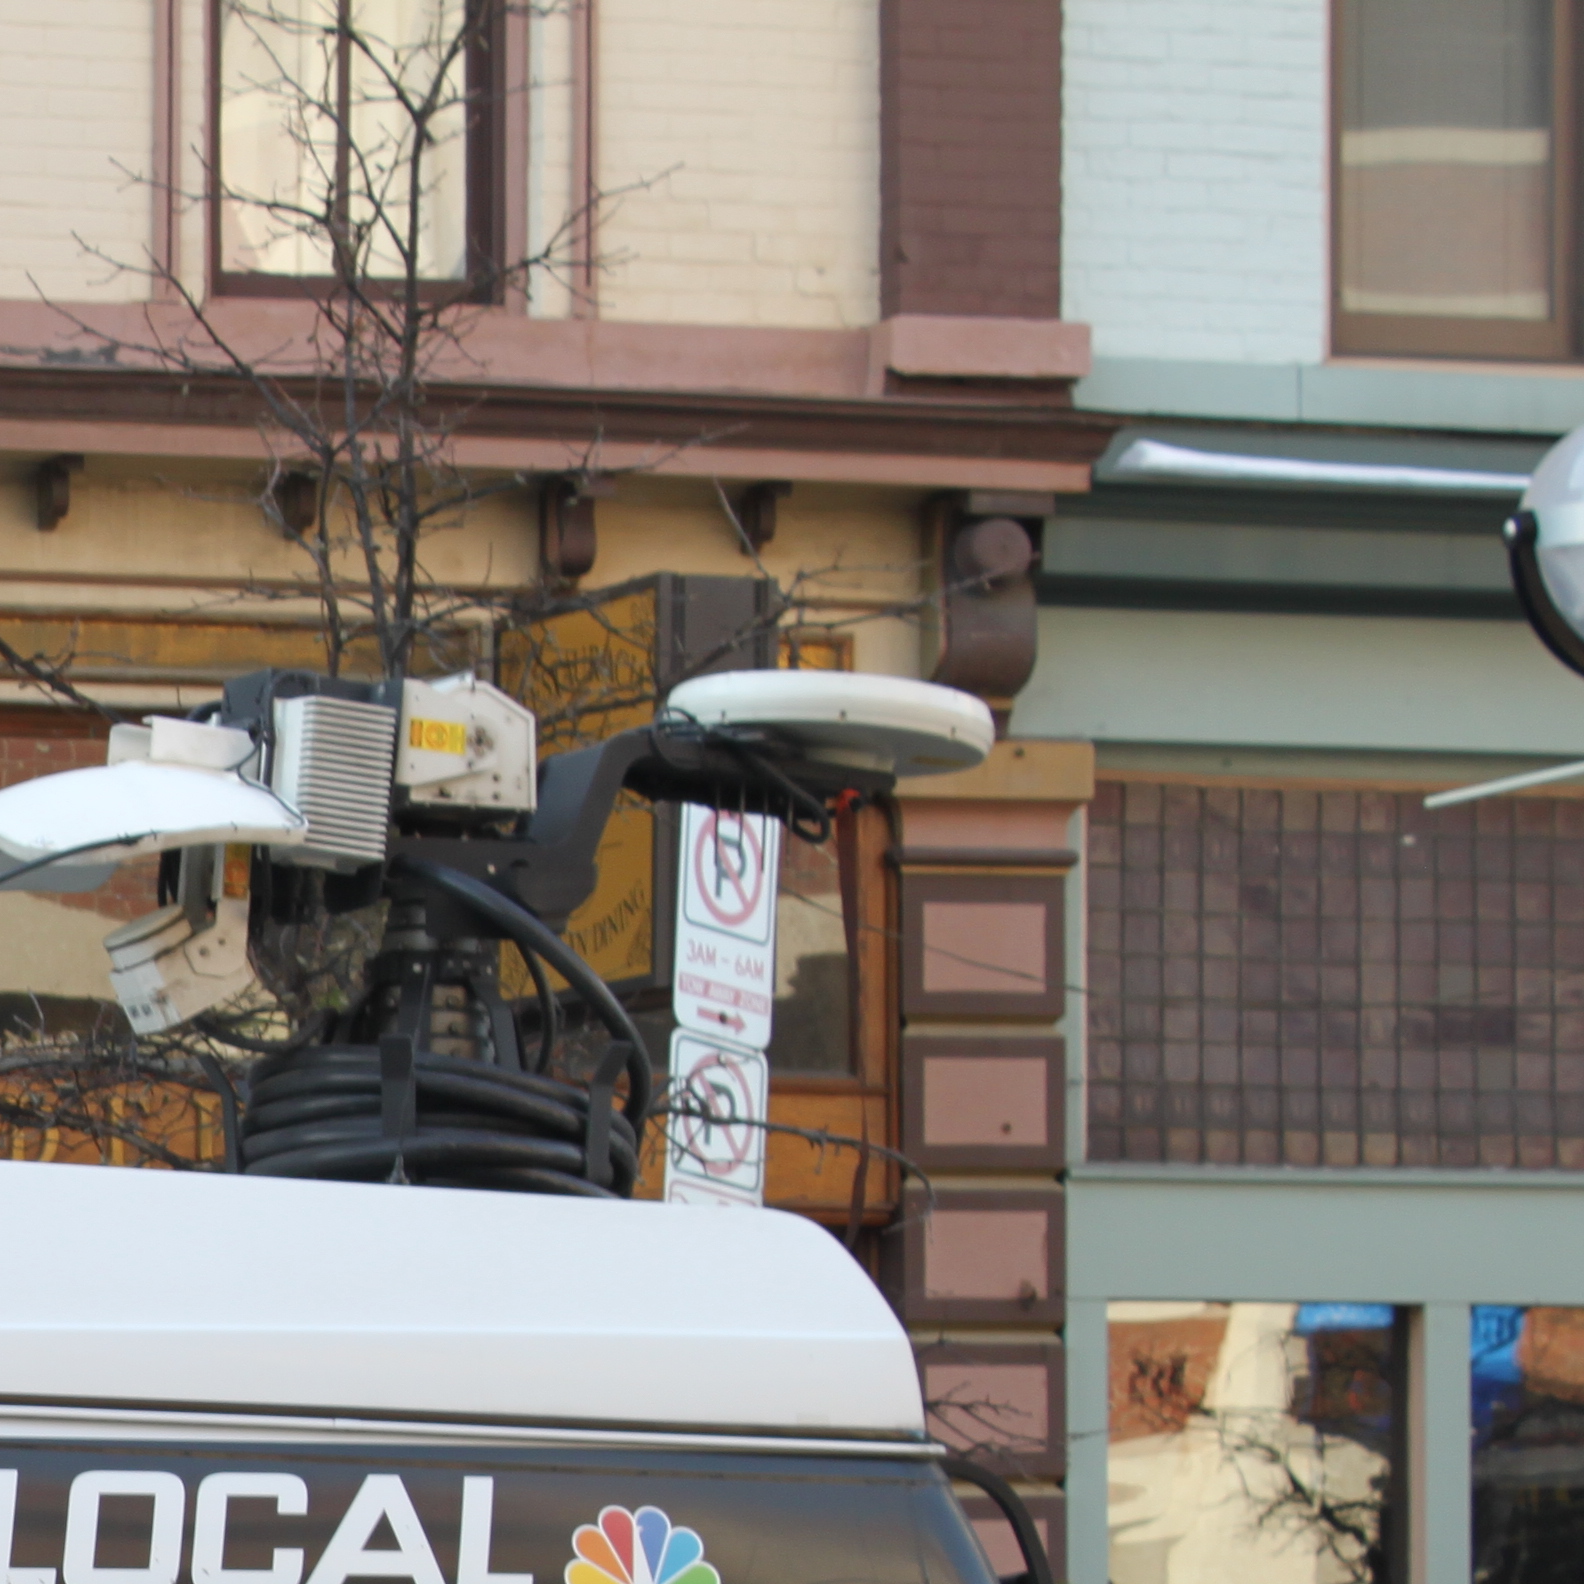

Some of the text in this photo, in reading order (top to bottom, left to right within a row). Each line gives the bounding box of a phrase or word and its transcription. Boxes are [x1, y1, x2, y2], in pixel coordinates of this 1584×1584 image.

[686, 938, 717, 968] 3AM
[735, 954, 764, 981] 6AM
[679, 972, 705, 994] TOW
